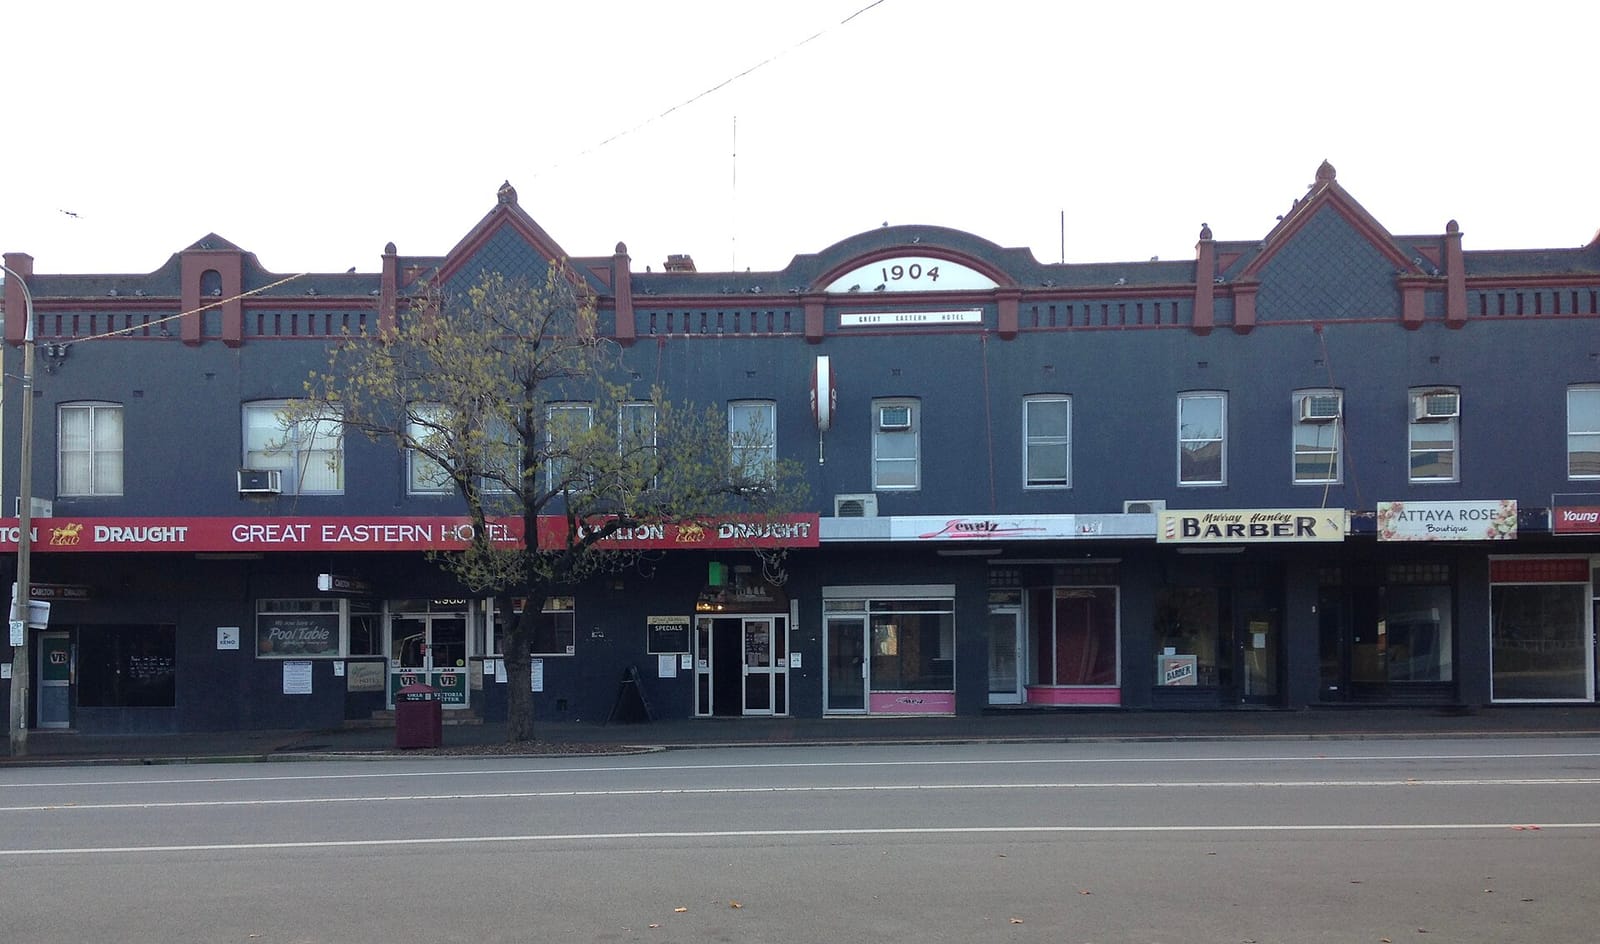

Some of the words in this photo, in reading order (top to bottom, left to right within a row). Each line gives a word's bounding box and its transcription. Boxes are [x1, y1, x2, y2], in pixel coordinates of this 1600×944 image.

[882, 263, 940, 281] 1904
[1202, 513, 1243, 523] Murray
[1250, 512, 1292, 523] Hanley
[1398, 509, 1454, 521] ATTAYA
[1459, 509, 1497, 521] ROSE
[1563, 511, 1599, 523] Young
[94, 525, 188, 543] DRAUGHT
[232, 524, 311, 543] GREAT
[322, 524, 433, 543] EASTERN
[441, 524, 518, 542] HOTEL
[719, 522, 811, 539] DRAUGHT
[1181, 516, 1317, 538] BARBER
[1425, 523, 1468, 534] Boutique
[269, 627, 297, 640] Pool
[298, 625, 330, 640] Table
[440, 675, 457, 687] VB
